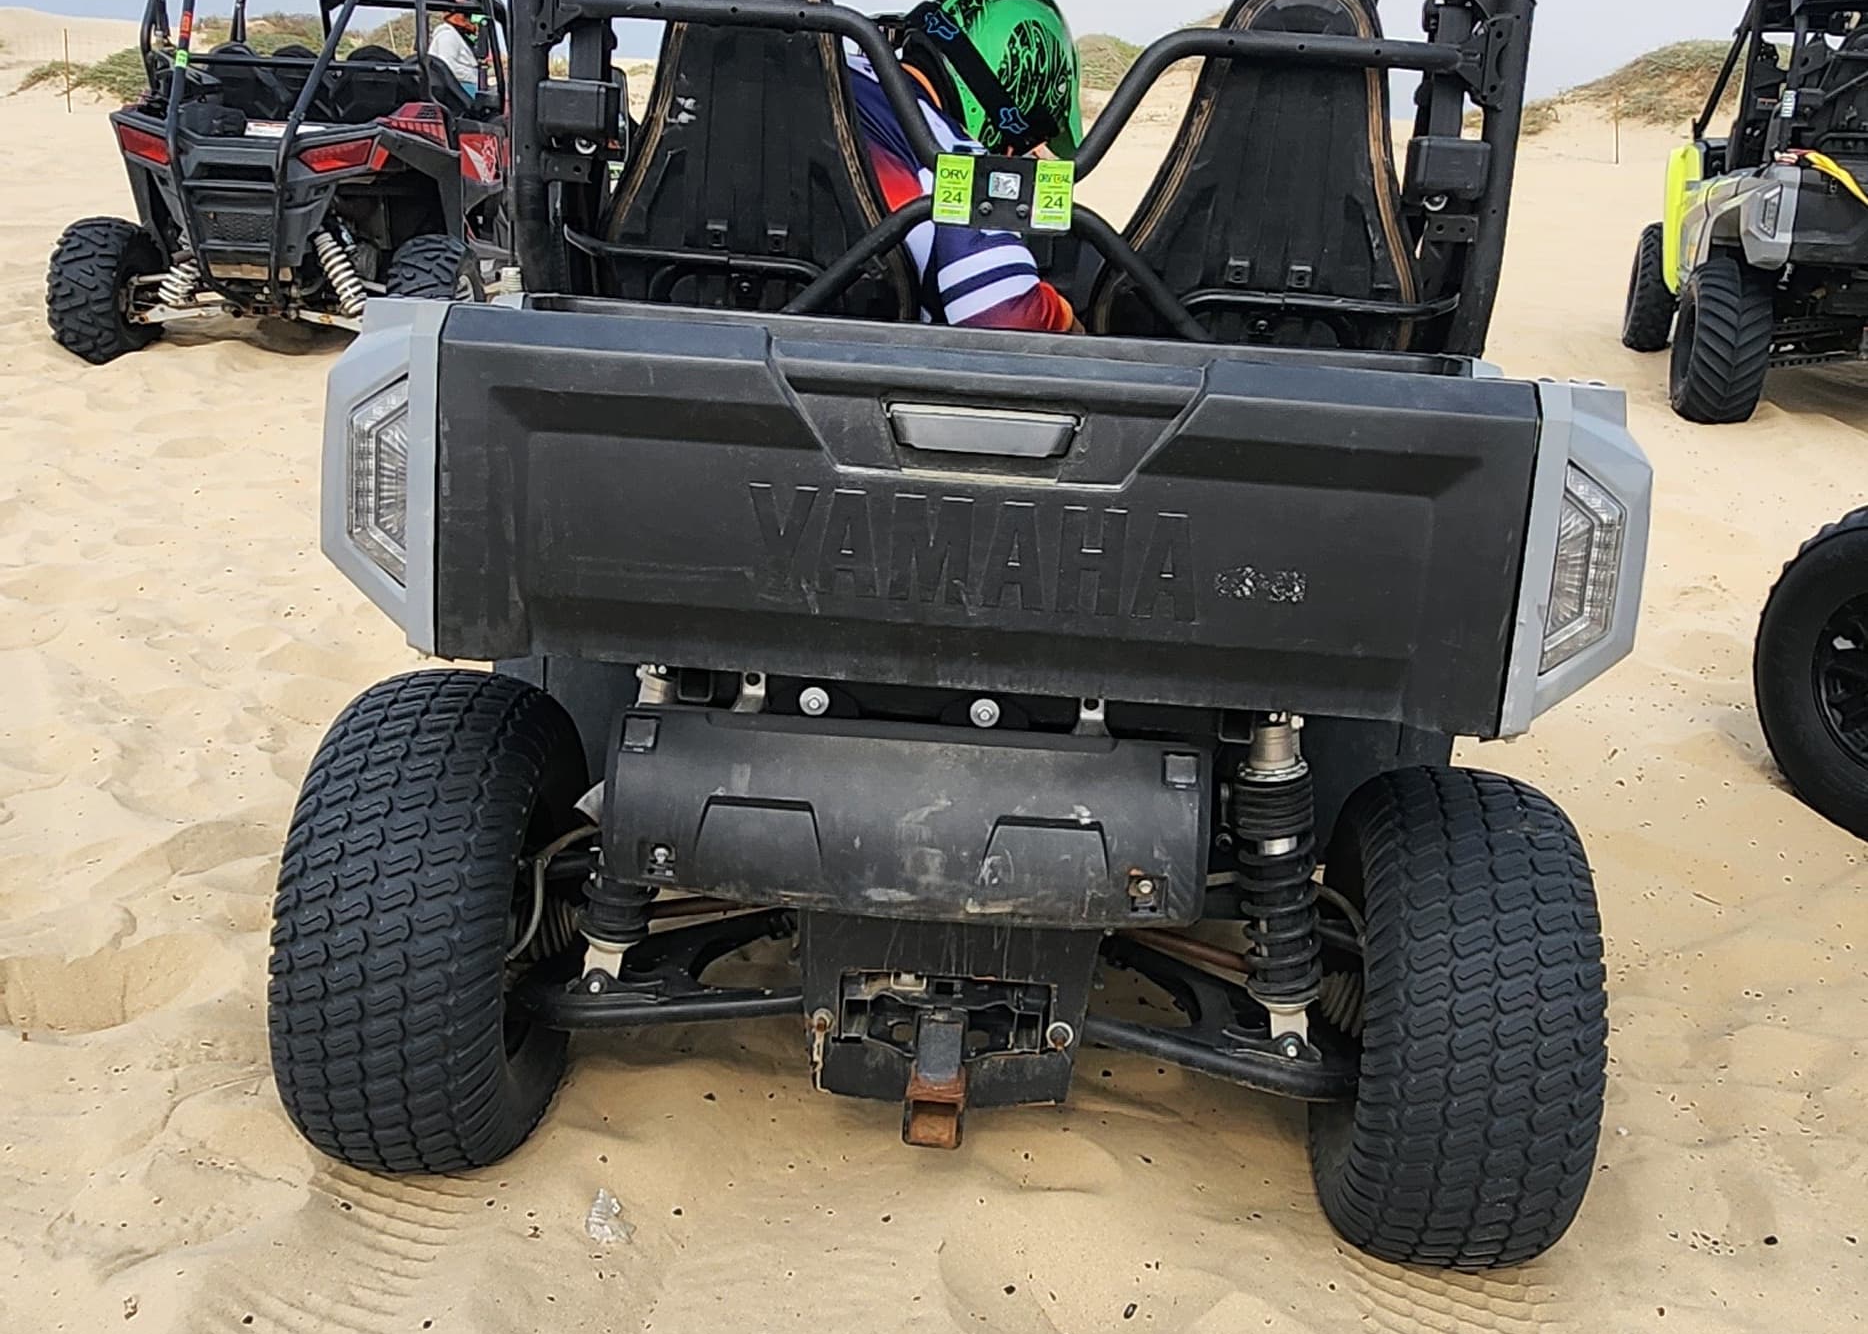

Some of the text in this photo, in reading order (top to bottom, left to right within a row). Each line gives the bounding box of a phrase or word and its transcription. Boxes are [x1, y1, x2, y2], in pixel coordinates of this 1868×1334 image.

[940, 168, 969, 180] ORV
[942, 190, 963, 204] 24
[1042, 195, 1064, 209] 24
[749, 481, 1200, 625] YAMAHA
